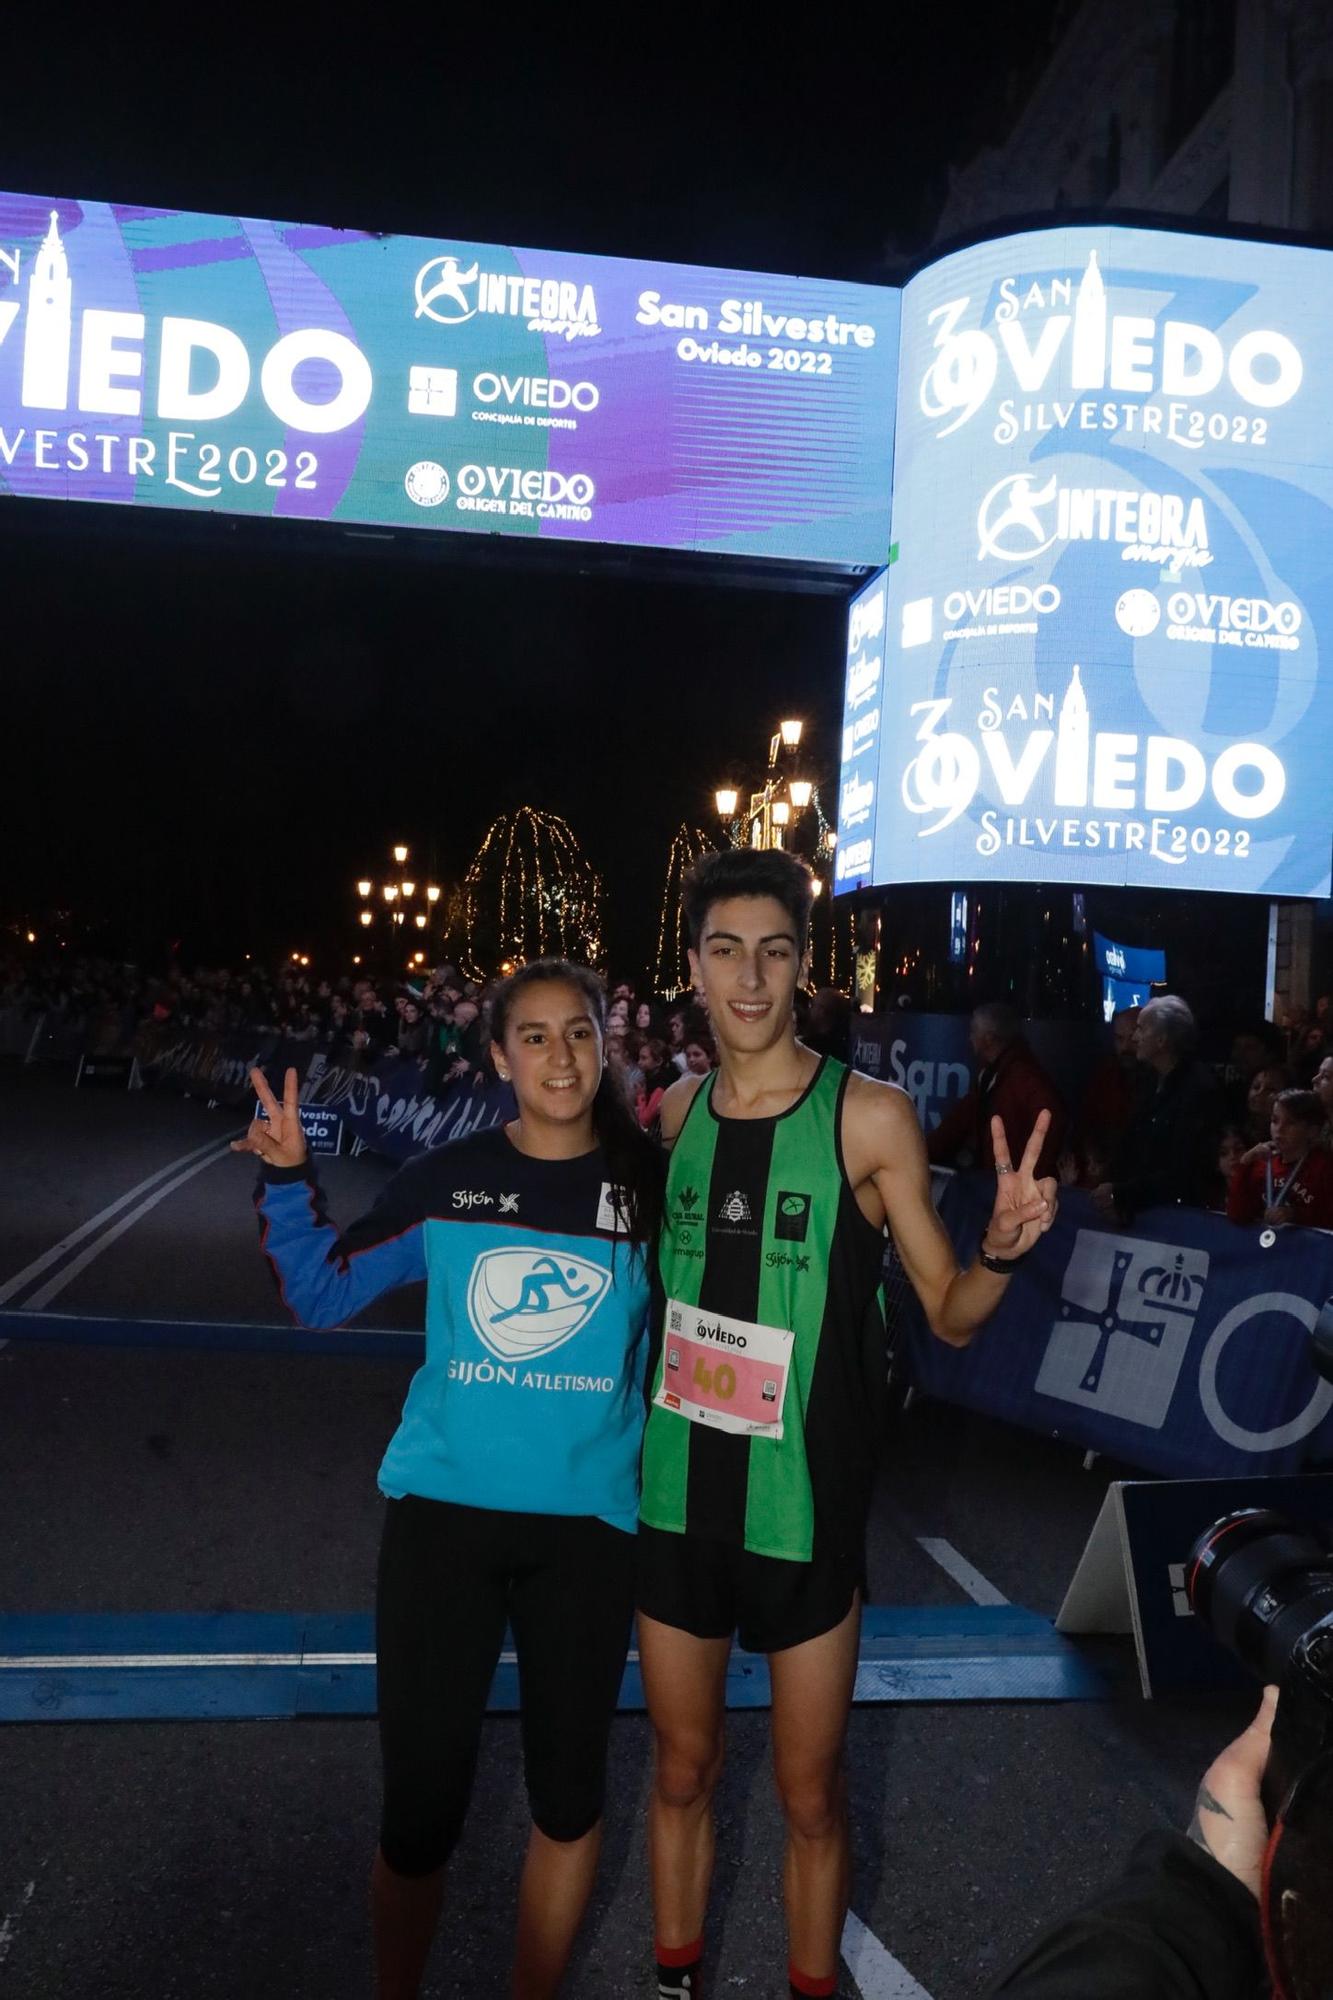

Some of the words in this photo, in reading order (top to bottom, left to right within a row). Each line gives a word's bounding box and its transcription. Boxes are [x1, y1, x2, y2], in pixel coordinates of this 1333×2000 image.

[0, 210, 373, 433] IEDO
[636, 291, 707, 331] San
[718, 299, 876, 348] Silvestre
[676, 338, 762, 369] Oviedo
[768, 346, 833, 375] 2022
[473, 372, 600, 412] OVIEDO
[457, 464, 594, 505] OVIEDO
[456, 496, 506, 515] ORIGEN
[509, 499, 535, 519] DEL
[536, 502, 593, 522] CAMINO
[943, 584, 1061, 622] OVIEDO
[1166, 592, 1302, 635] OVIEDO
[977, 687, 1055, 731] SAN
[888, 1039, 971, 1099] San
[447, 1359, 516, 1386] GIJÓN
[521, 1375, 614, 1393] ATLETISMO
[691, 1356, 737, 1401] 40
